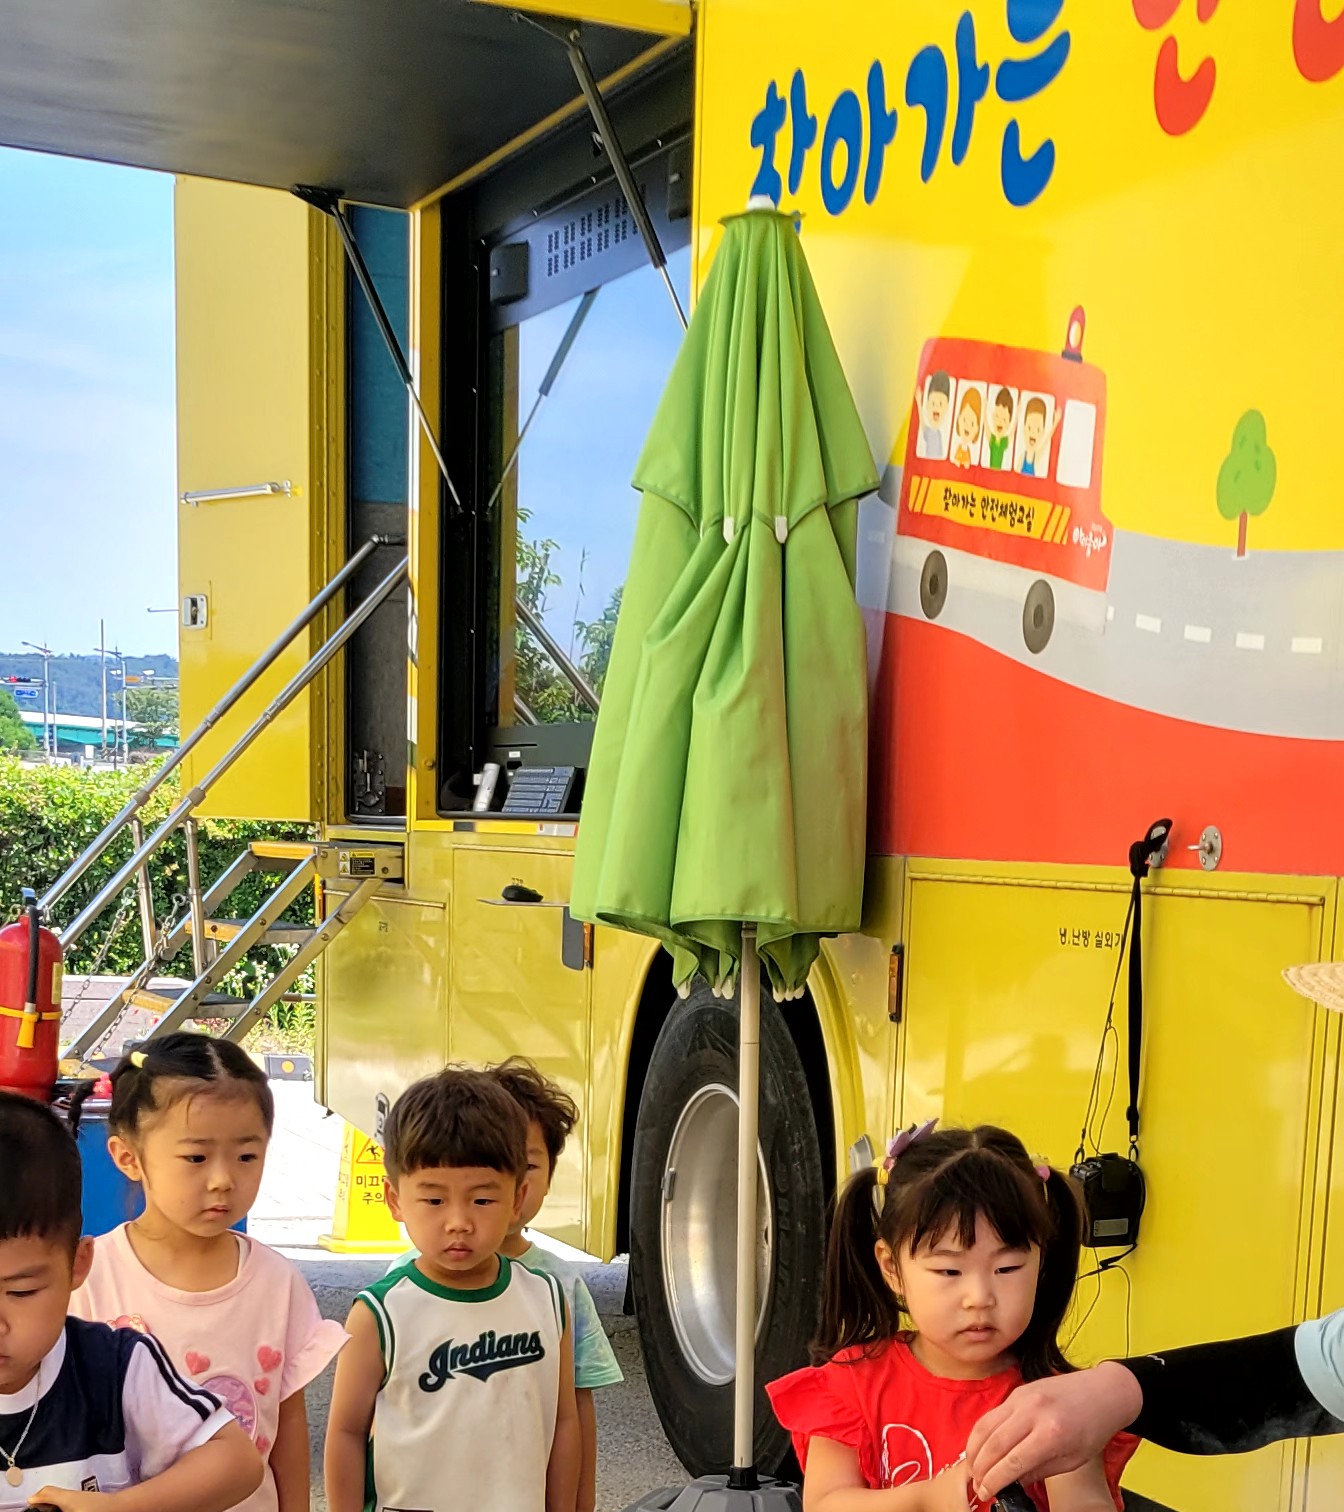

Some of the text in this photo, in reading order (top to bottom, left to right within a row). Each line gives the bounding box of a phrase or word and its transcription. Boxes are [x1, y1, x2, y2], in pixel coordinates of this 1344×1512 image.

[943, 487, 1035, 532] 찾아가는 안전체험교실
[1059, 928, 1091, 948] 냉.난방
[362, 1192, 386, 1204] 주의
[418, 1329, 546, 1393] Indians
